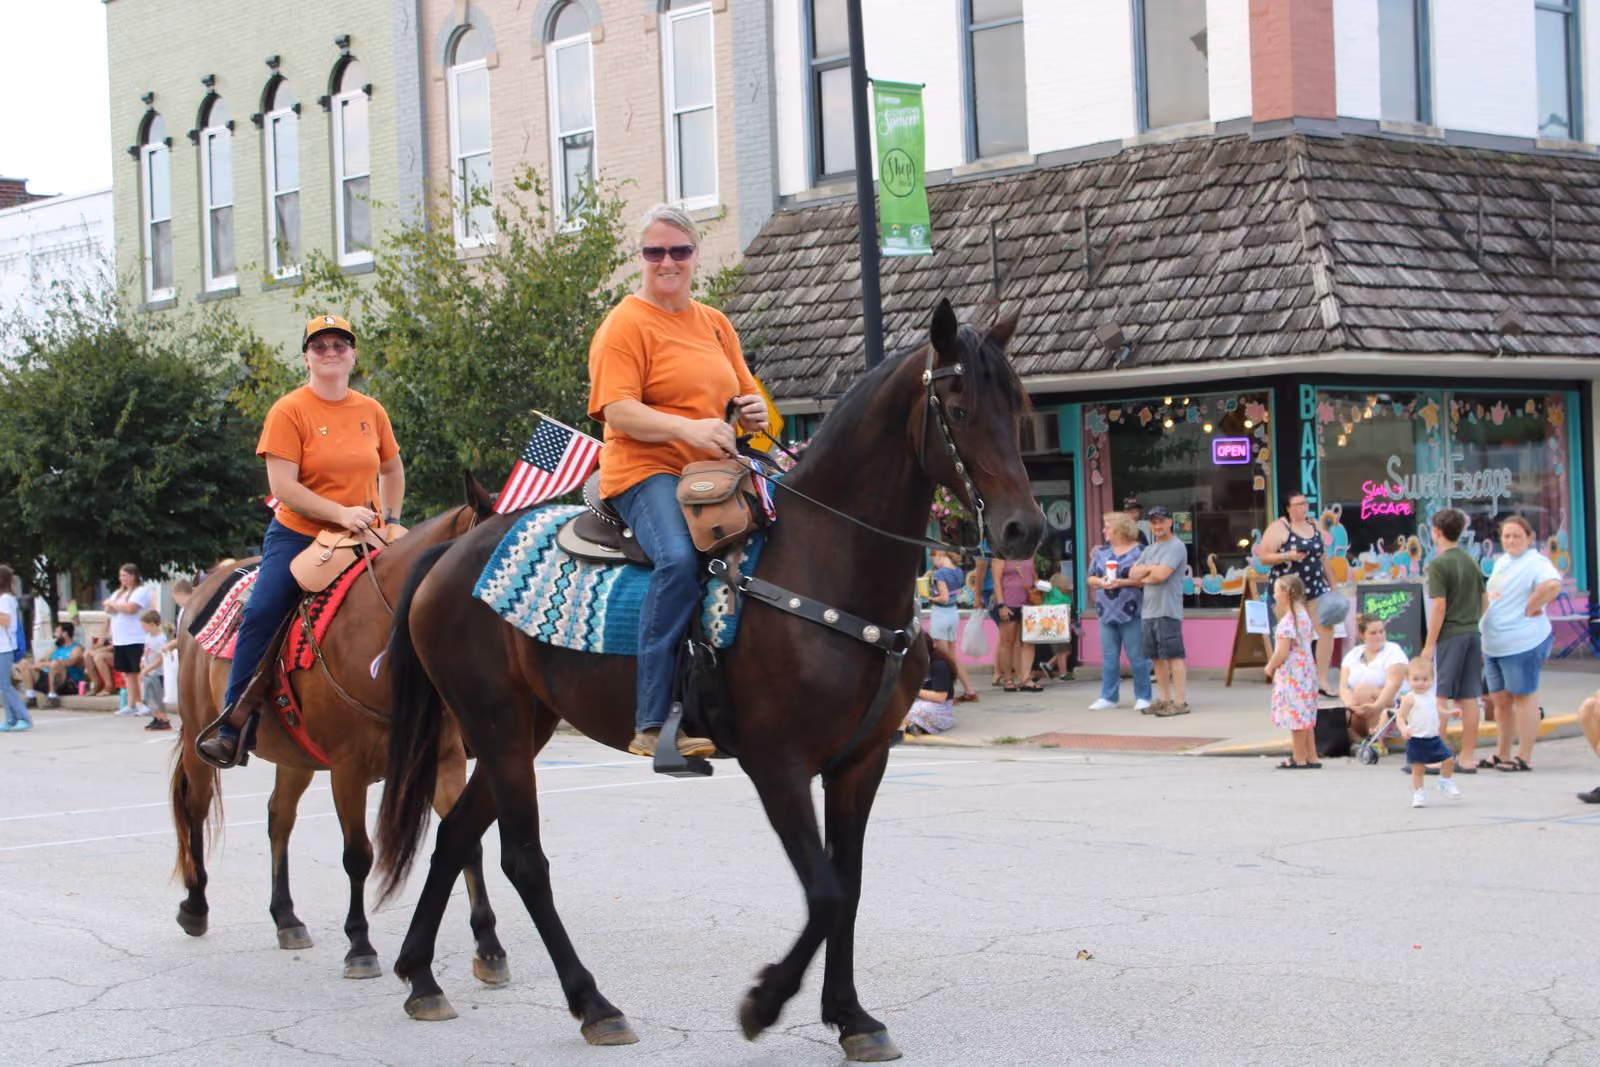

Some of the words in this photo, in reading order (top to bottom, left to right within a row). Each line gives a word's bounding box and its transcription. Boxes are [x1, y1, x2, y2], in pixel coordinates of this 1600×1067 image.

[1217, 444, 1247, 457] OPEN
[1383, 454, 1448, 501] Sweet
[1451, 453, 1513, 520] Escape
